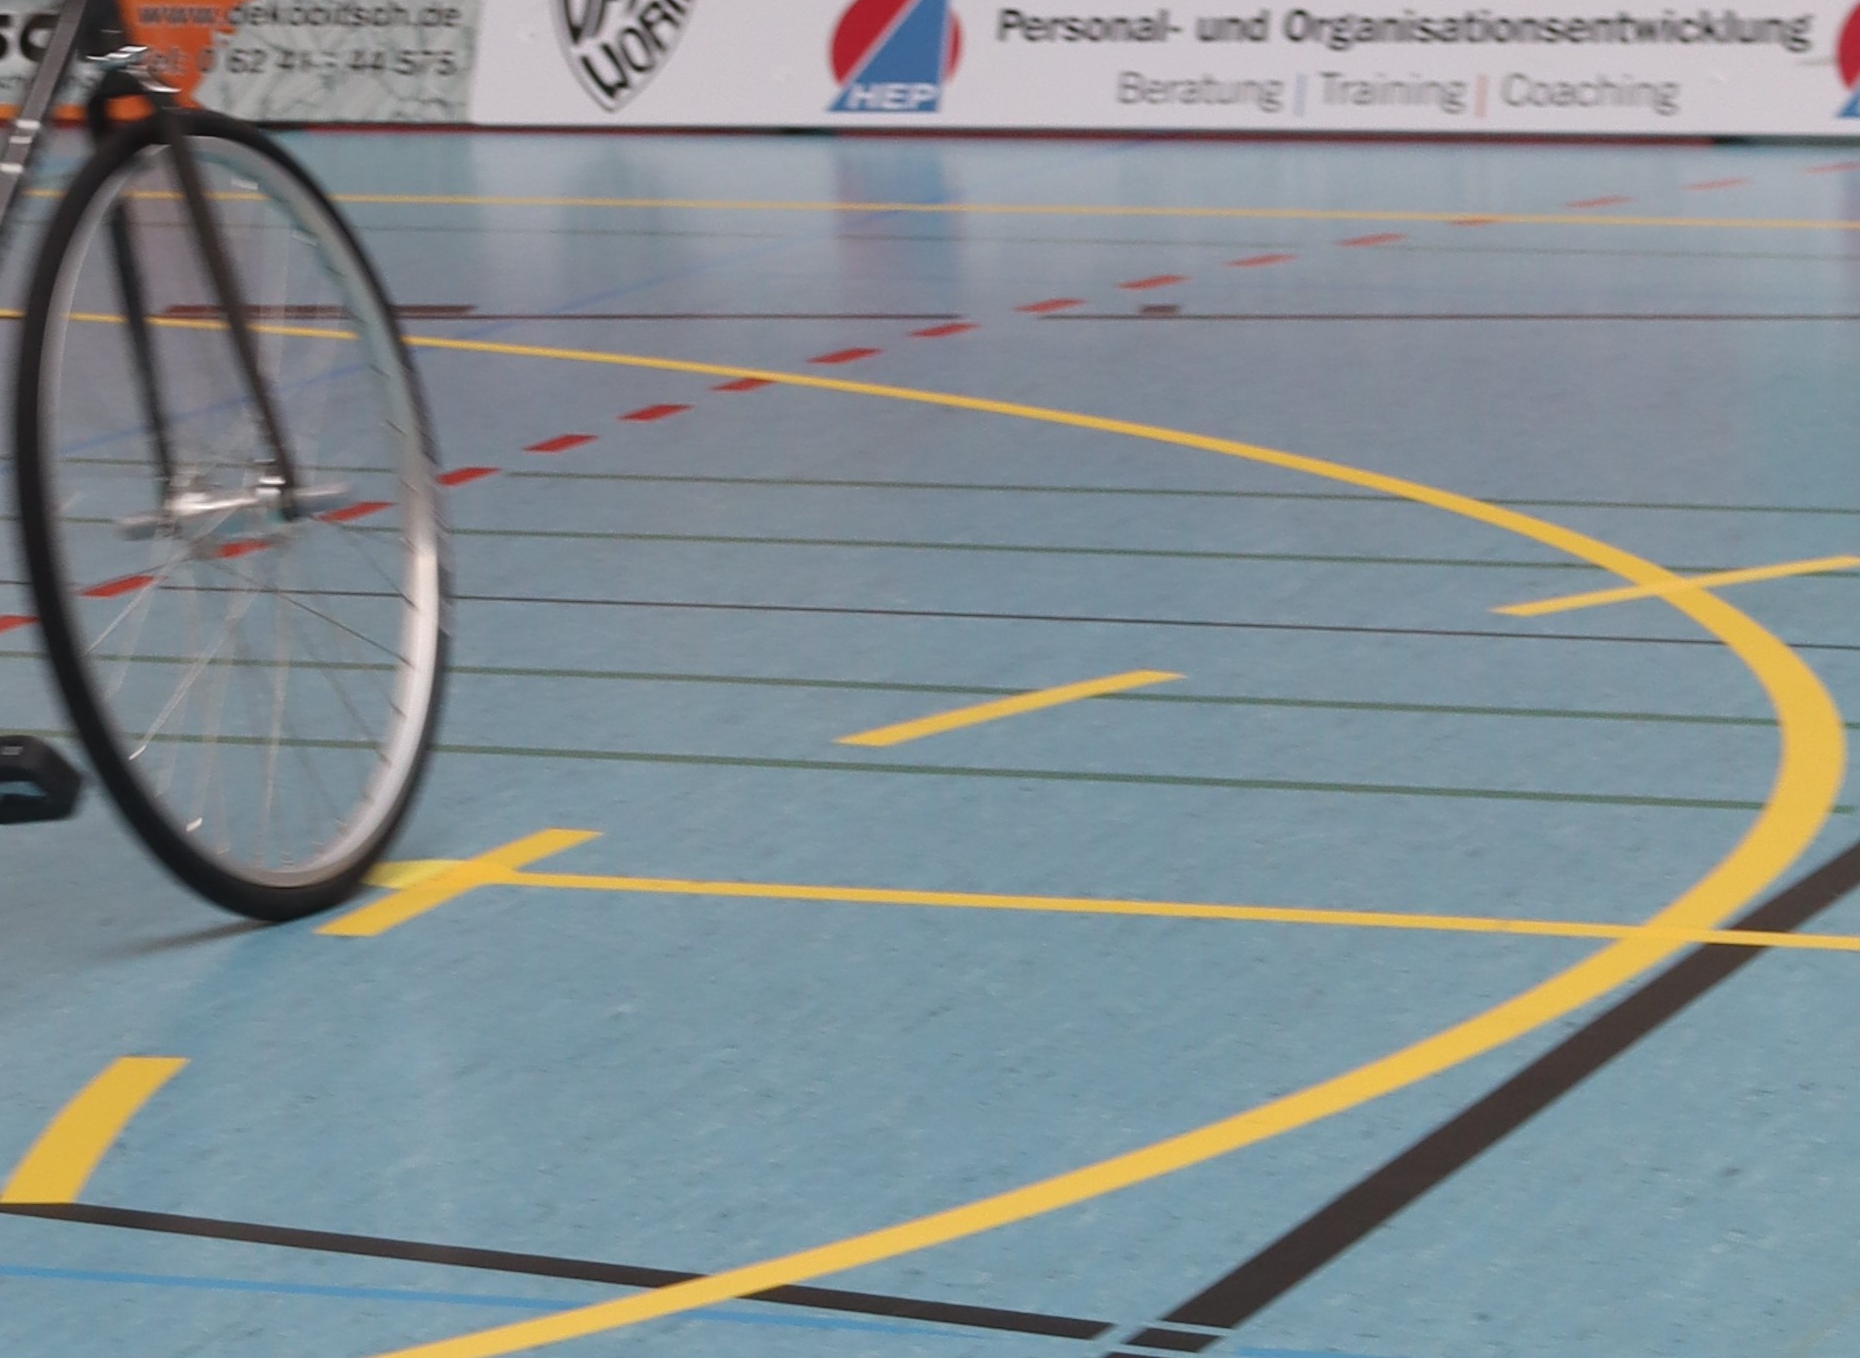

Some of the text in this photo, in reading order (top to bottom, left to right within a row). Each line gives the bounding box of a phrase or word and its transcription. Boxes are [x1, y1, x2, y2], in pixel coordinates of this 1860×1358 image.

[996, 9, 1815, 52] Personal- und Organisationsentwicklung
[1115, 71, 1680, 116] Beratung Training Coaching
